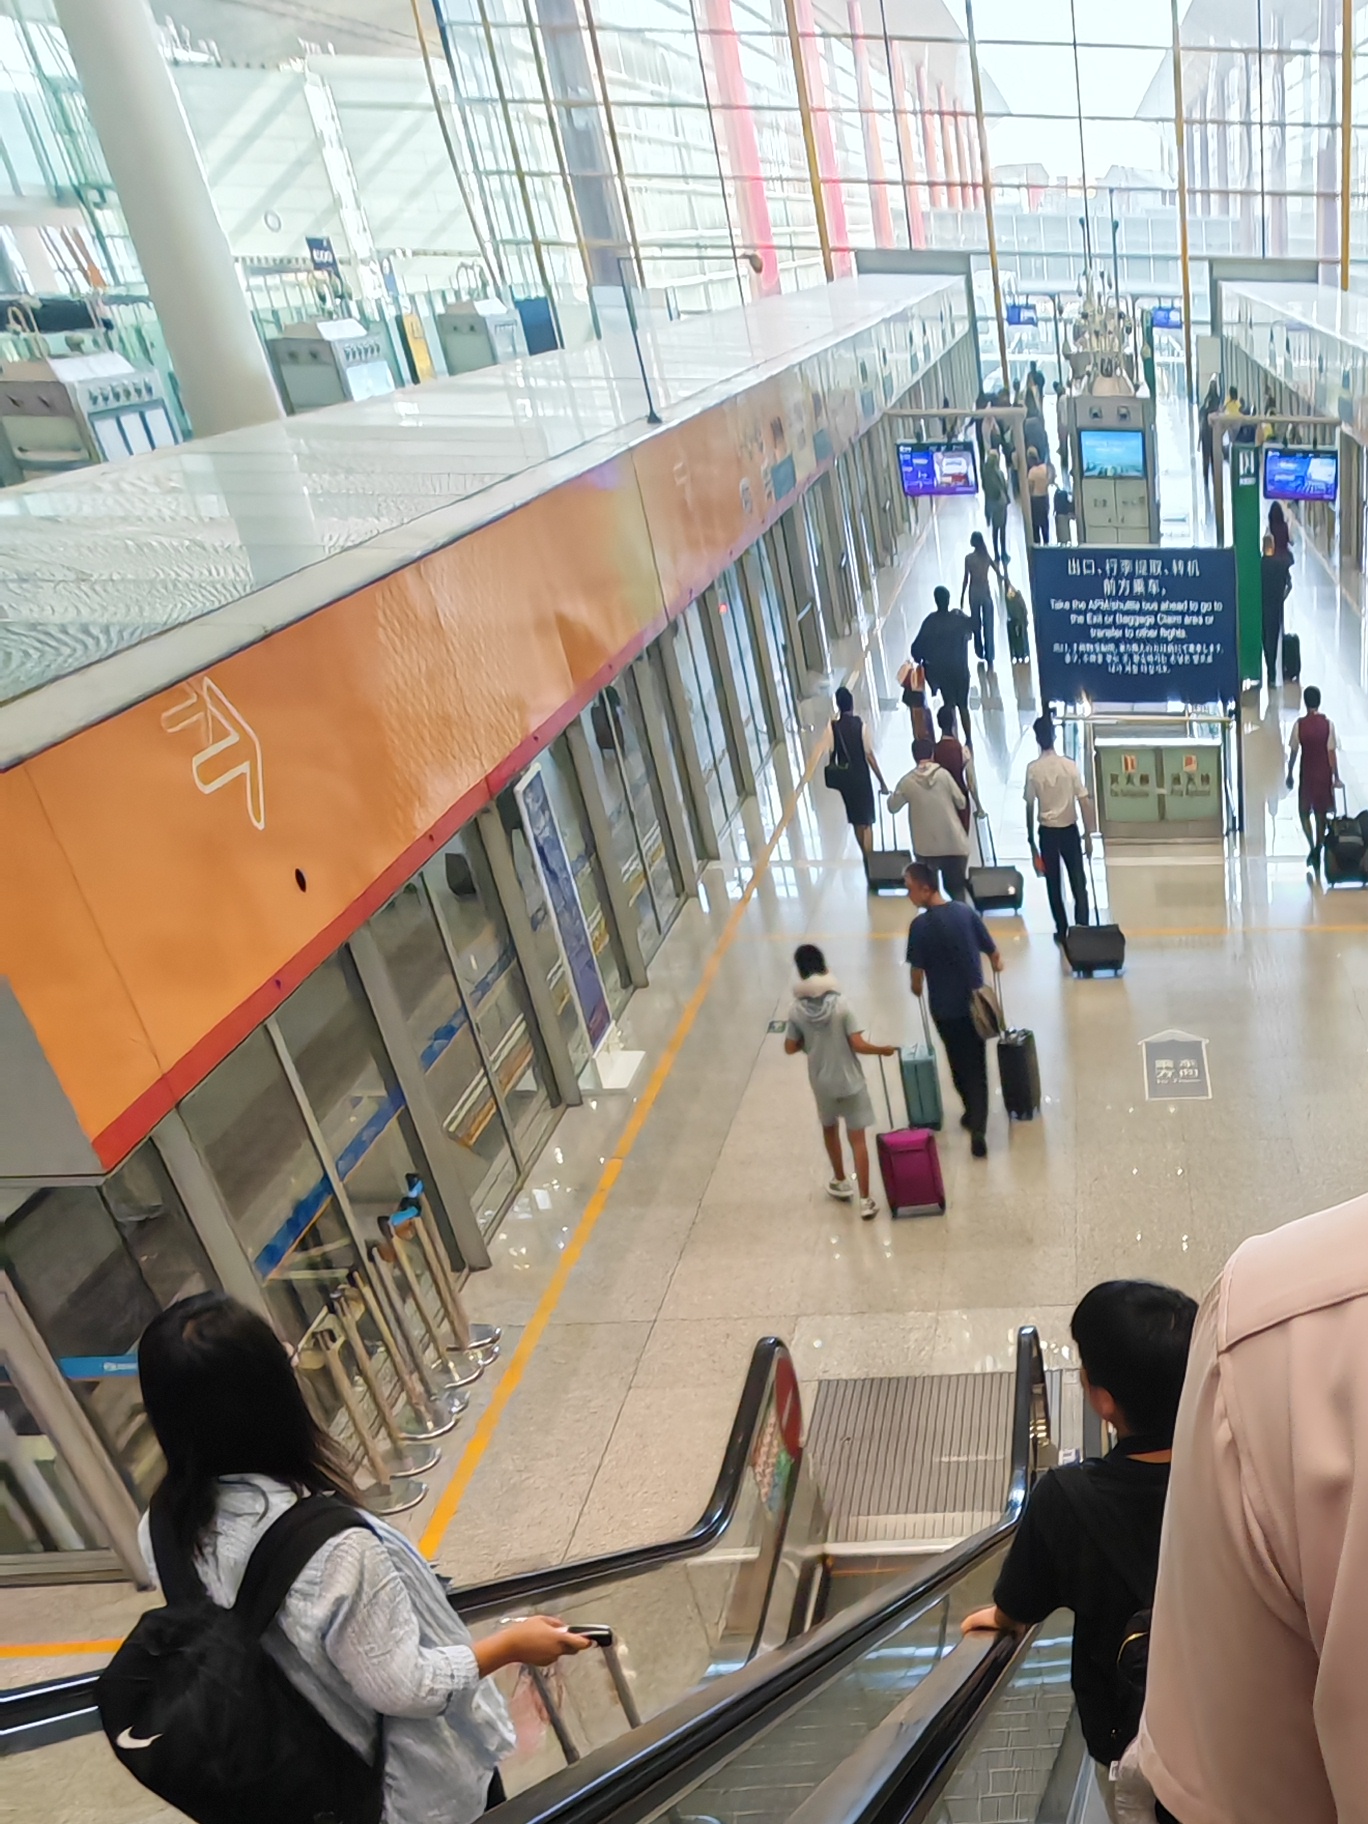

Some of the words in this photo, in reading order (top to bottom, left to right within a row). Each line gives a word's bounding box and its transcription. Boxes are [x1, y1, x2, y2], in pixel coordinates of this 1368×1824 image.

[1189, 600, 1198, 612] to
[1200, 601, 1212, 614] go
[1214, 600, 1223, 612] to
